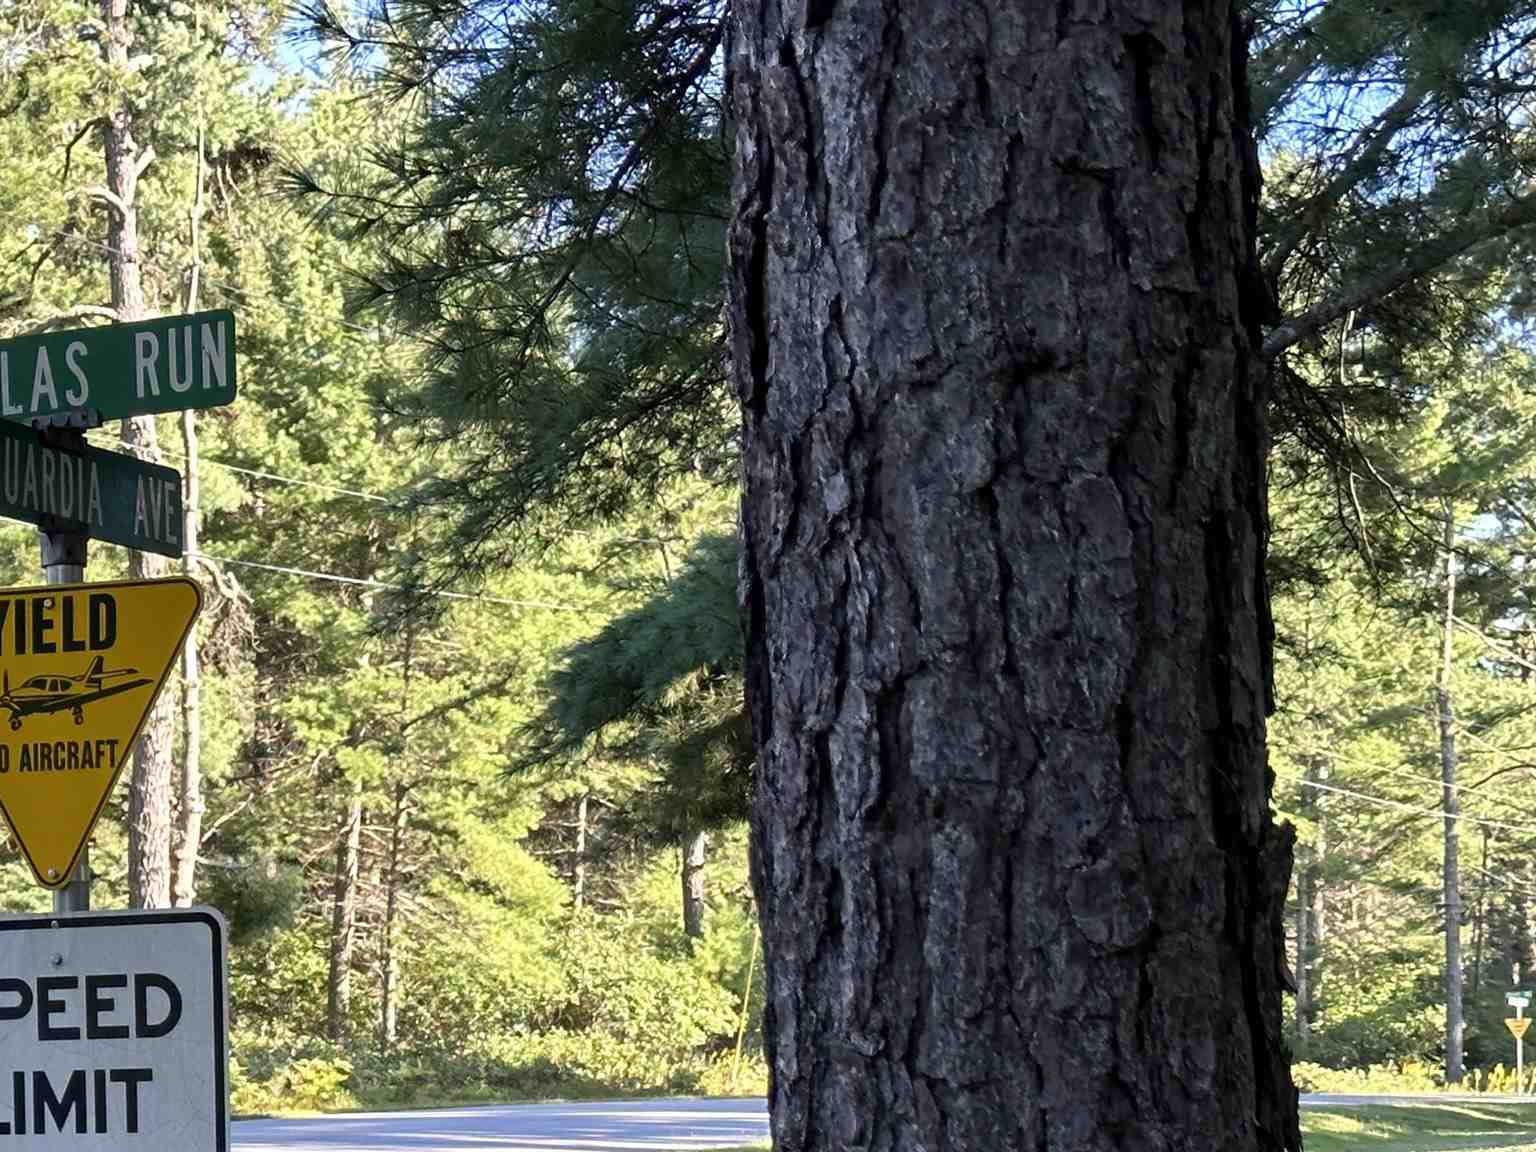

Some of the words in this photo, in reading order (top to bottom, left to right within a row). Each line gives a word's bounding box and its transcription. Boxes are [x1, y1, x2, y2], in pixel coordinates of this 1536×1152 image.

[134, 320, 228, 399] RUN
[134, 473, 178, 545] AVE
[19, 738, 119, 773] AIRCRAFT
